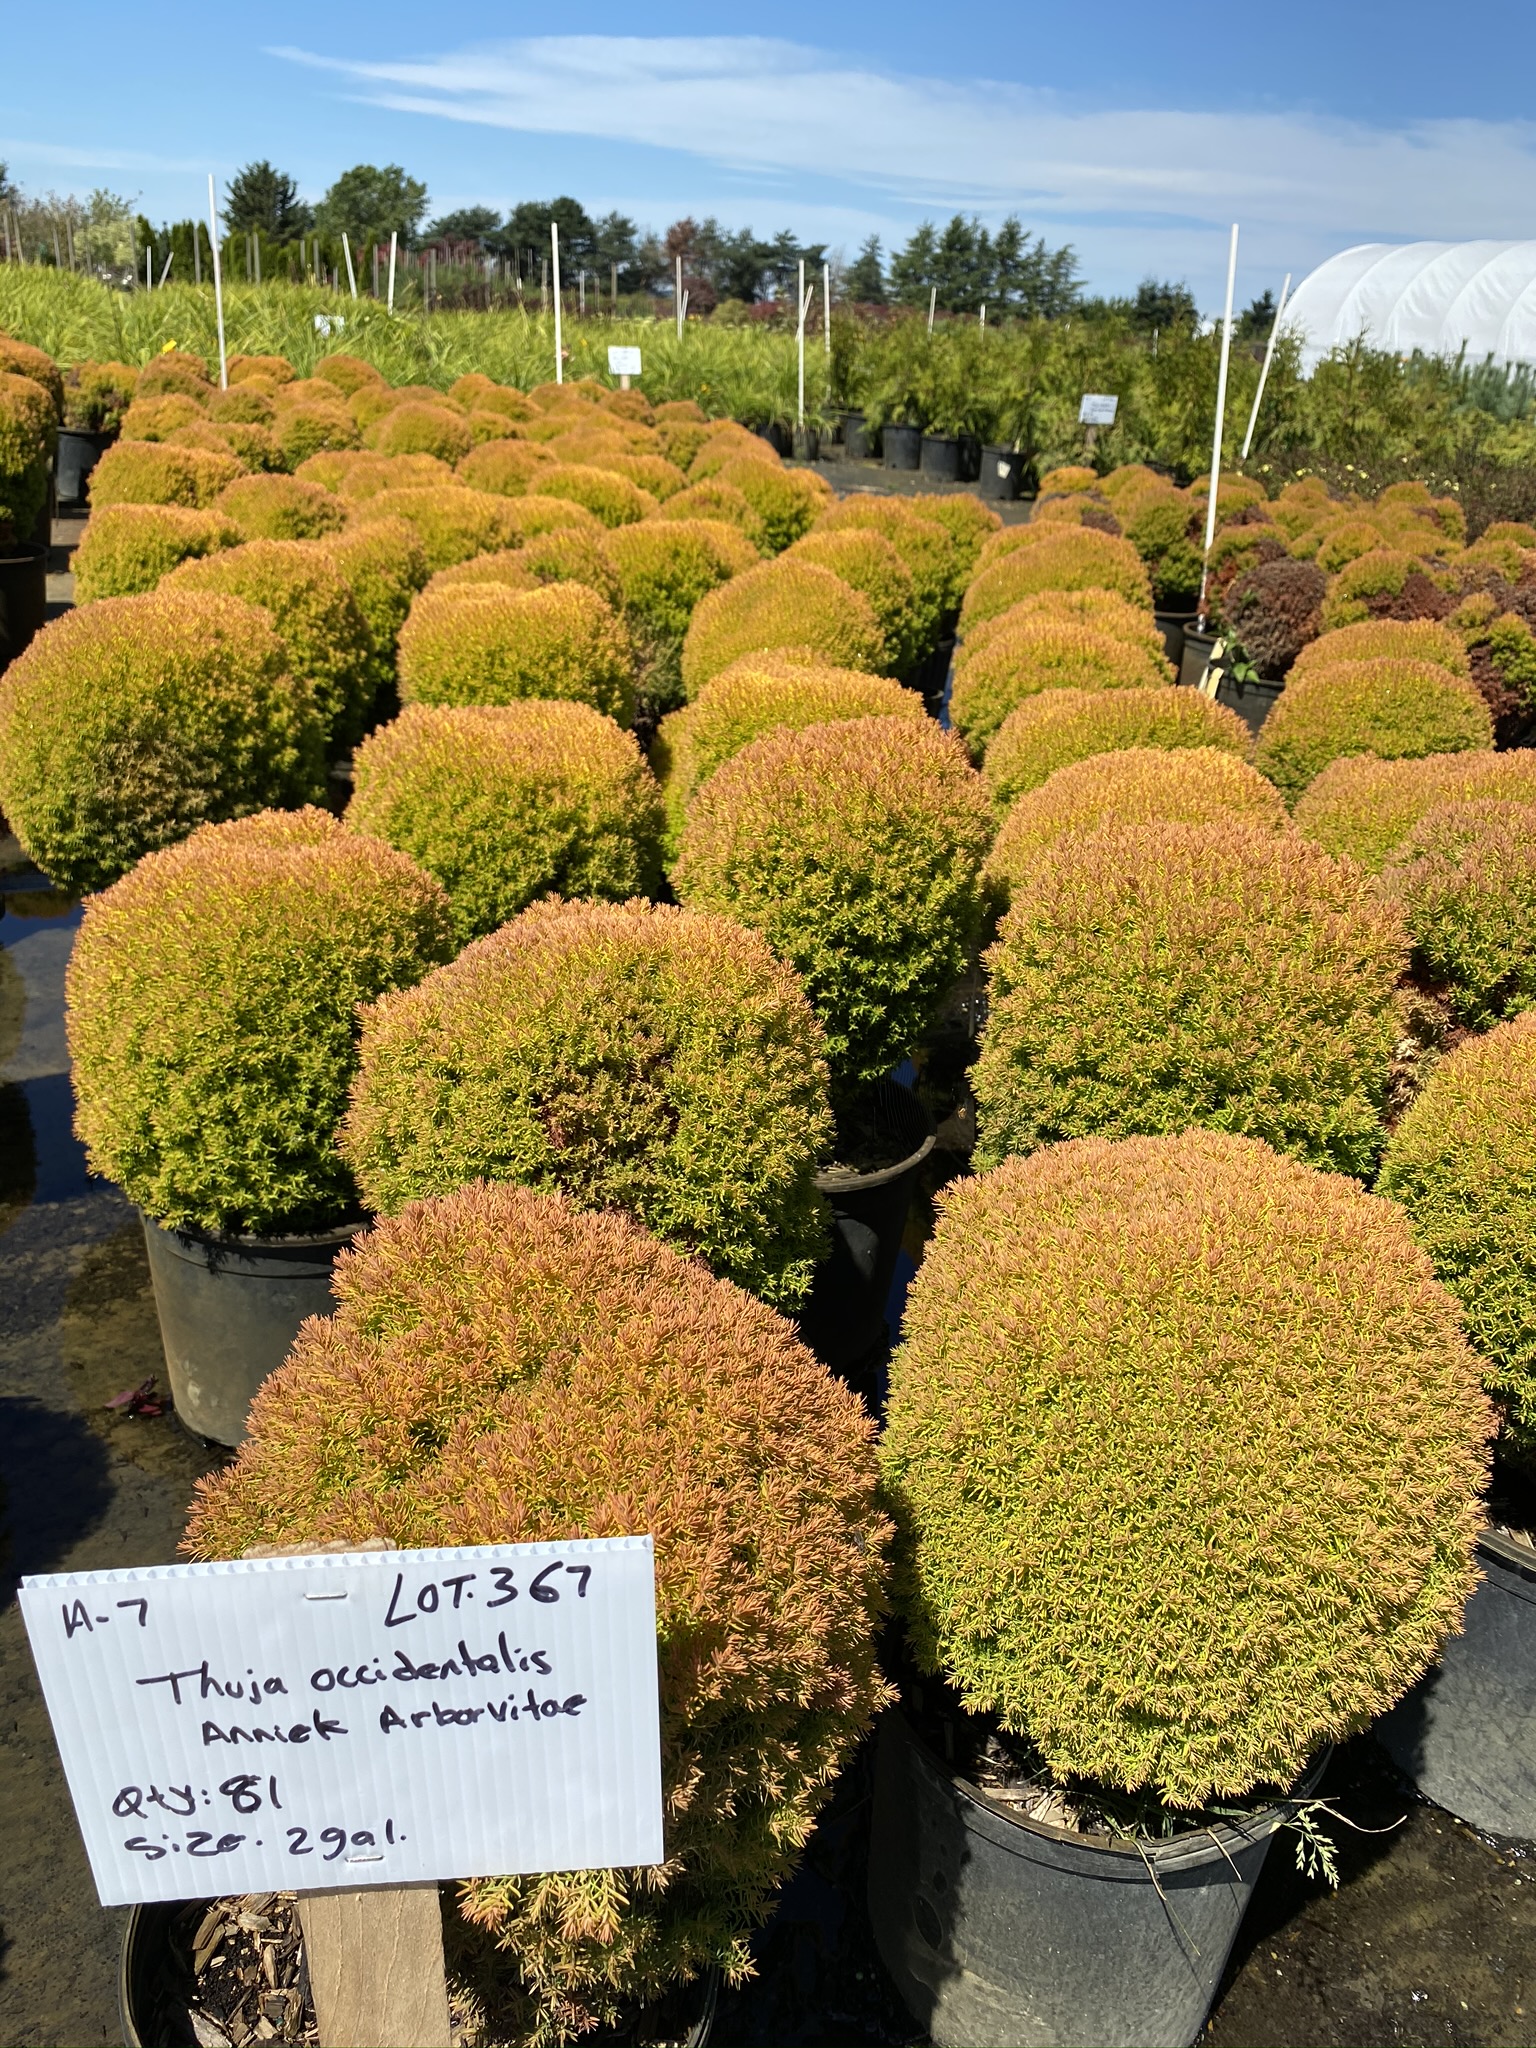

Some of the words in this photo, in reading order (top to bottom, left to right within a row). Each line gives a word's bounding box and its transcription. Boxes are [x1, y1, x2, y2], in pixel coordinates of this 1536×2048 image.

[62, 1597, 149, 1639] A-7
[135, 1660, 289, 1705] Thuja
[309, 1630, 552, 1692] occidentalis
[379, 1687, 588, 1734] Arborvitae
